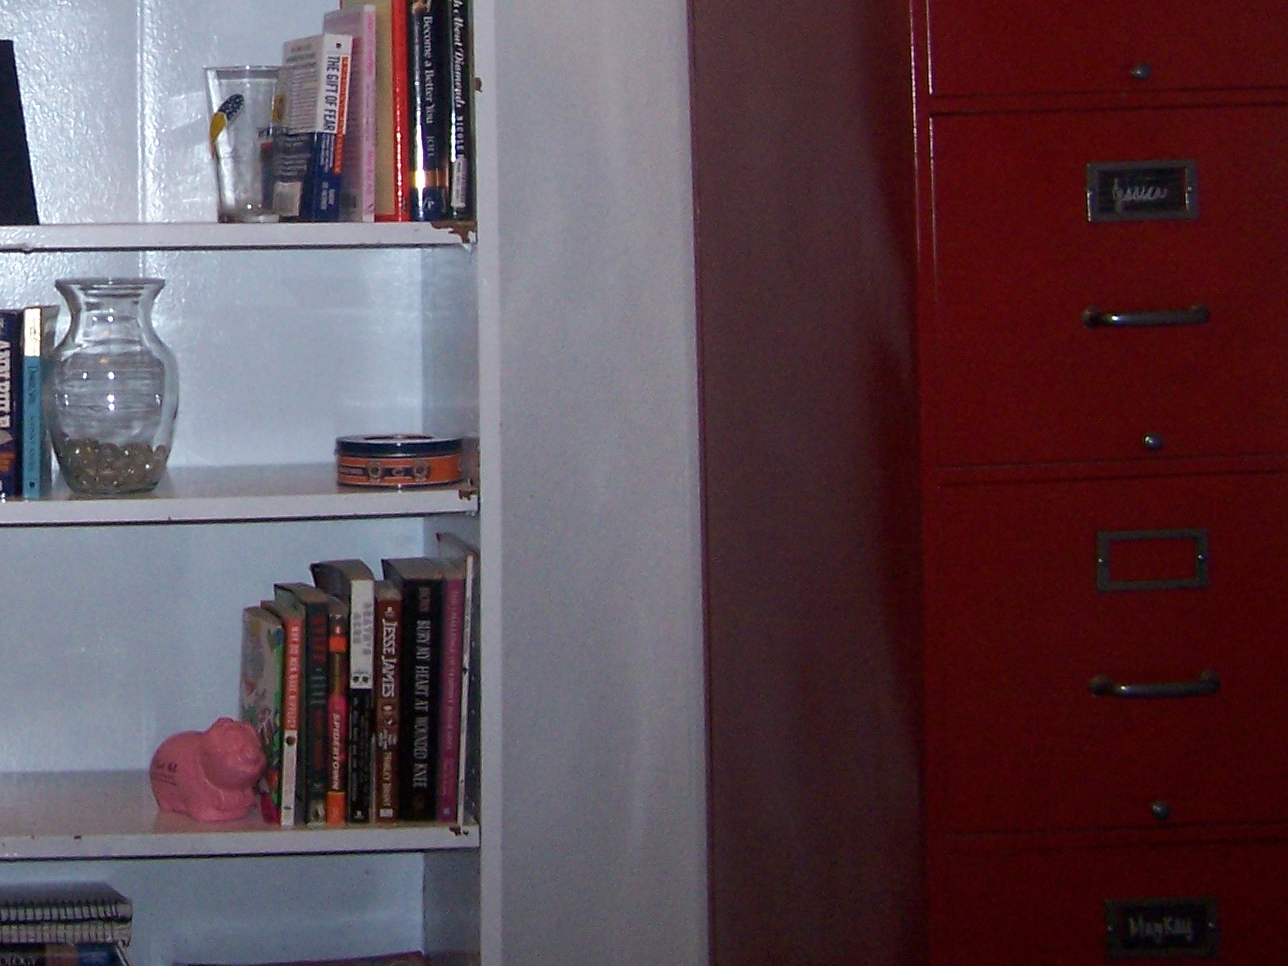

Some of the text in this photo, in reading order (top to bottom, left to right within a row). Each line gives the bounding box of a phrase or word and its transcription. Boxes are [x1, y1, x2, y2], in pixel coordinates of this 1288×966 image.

[423, 16, 434, 58] Become
[327, 56, 340, 72] THE
[453, 48, 465, 108] Diamonds
[325, 74, 339, 93] GIFT
[424, 70, 434, 102] Better
[325, 95, 337, 106] OF
[425, 104, 435, 124] You
[323, 109, 335, 131] FEAR
[381, 619, 397, 698] JESSE JAMES
[412, 620, 432, 788] BURY MY HEART AT WOUNDED KNEE
[332, 713, 341, 790] SPIDERTOWN
